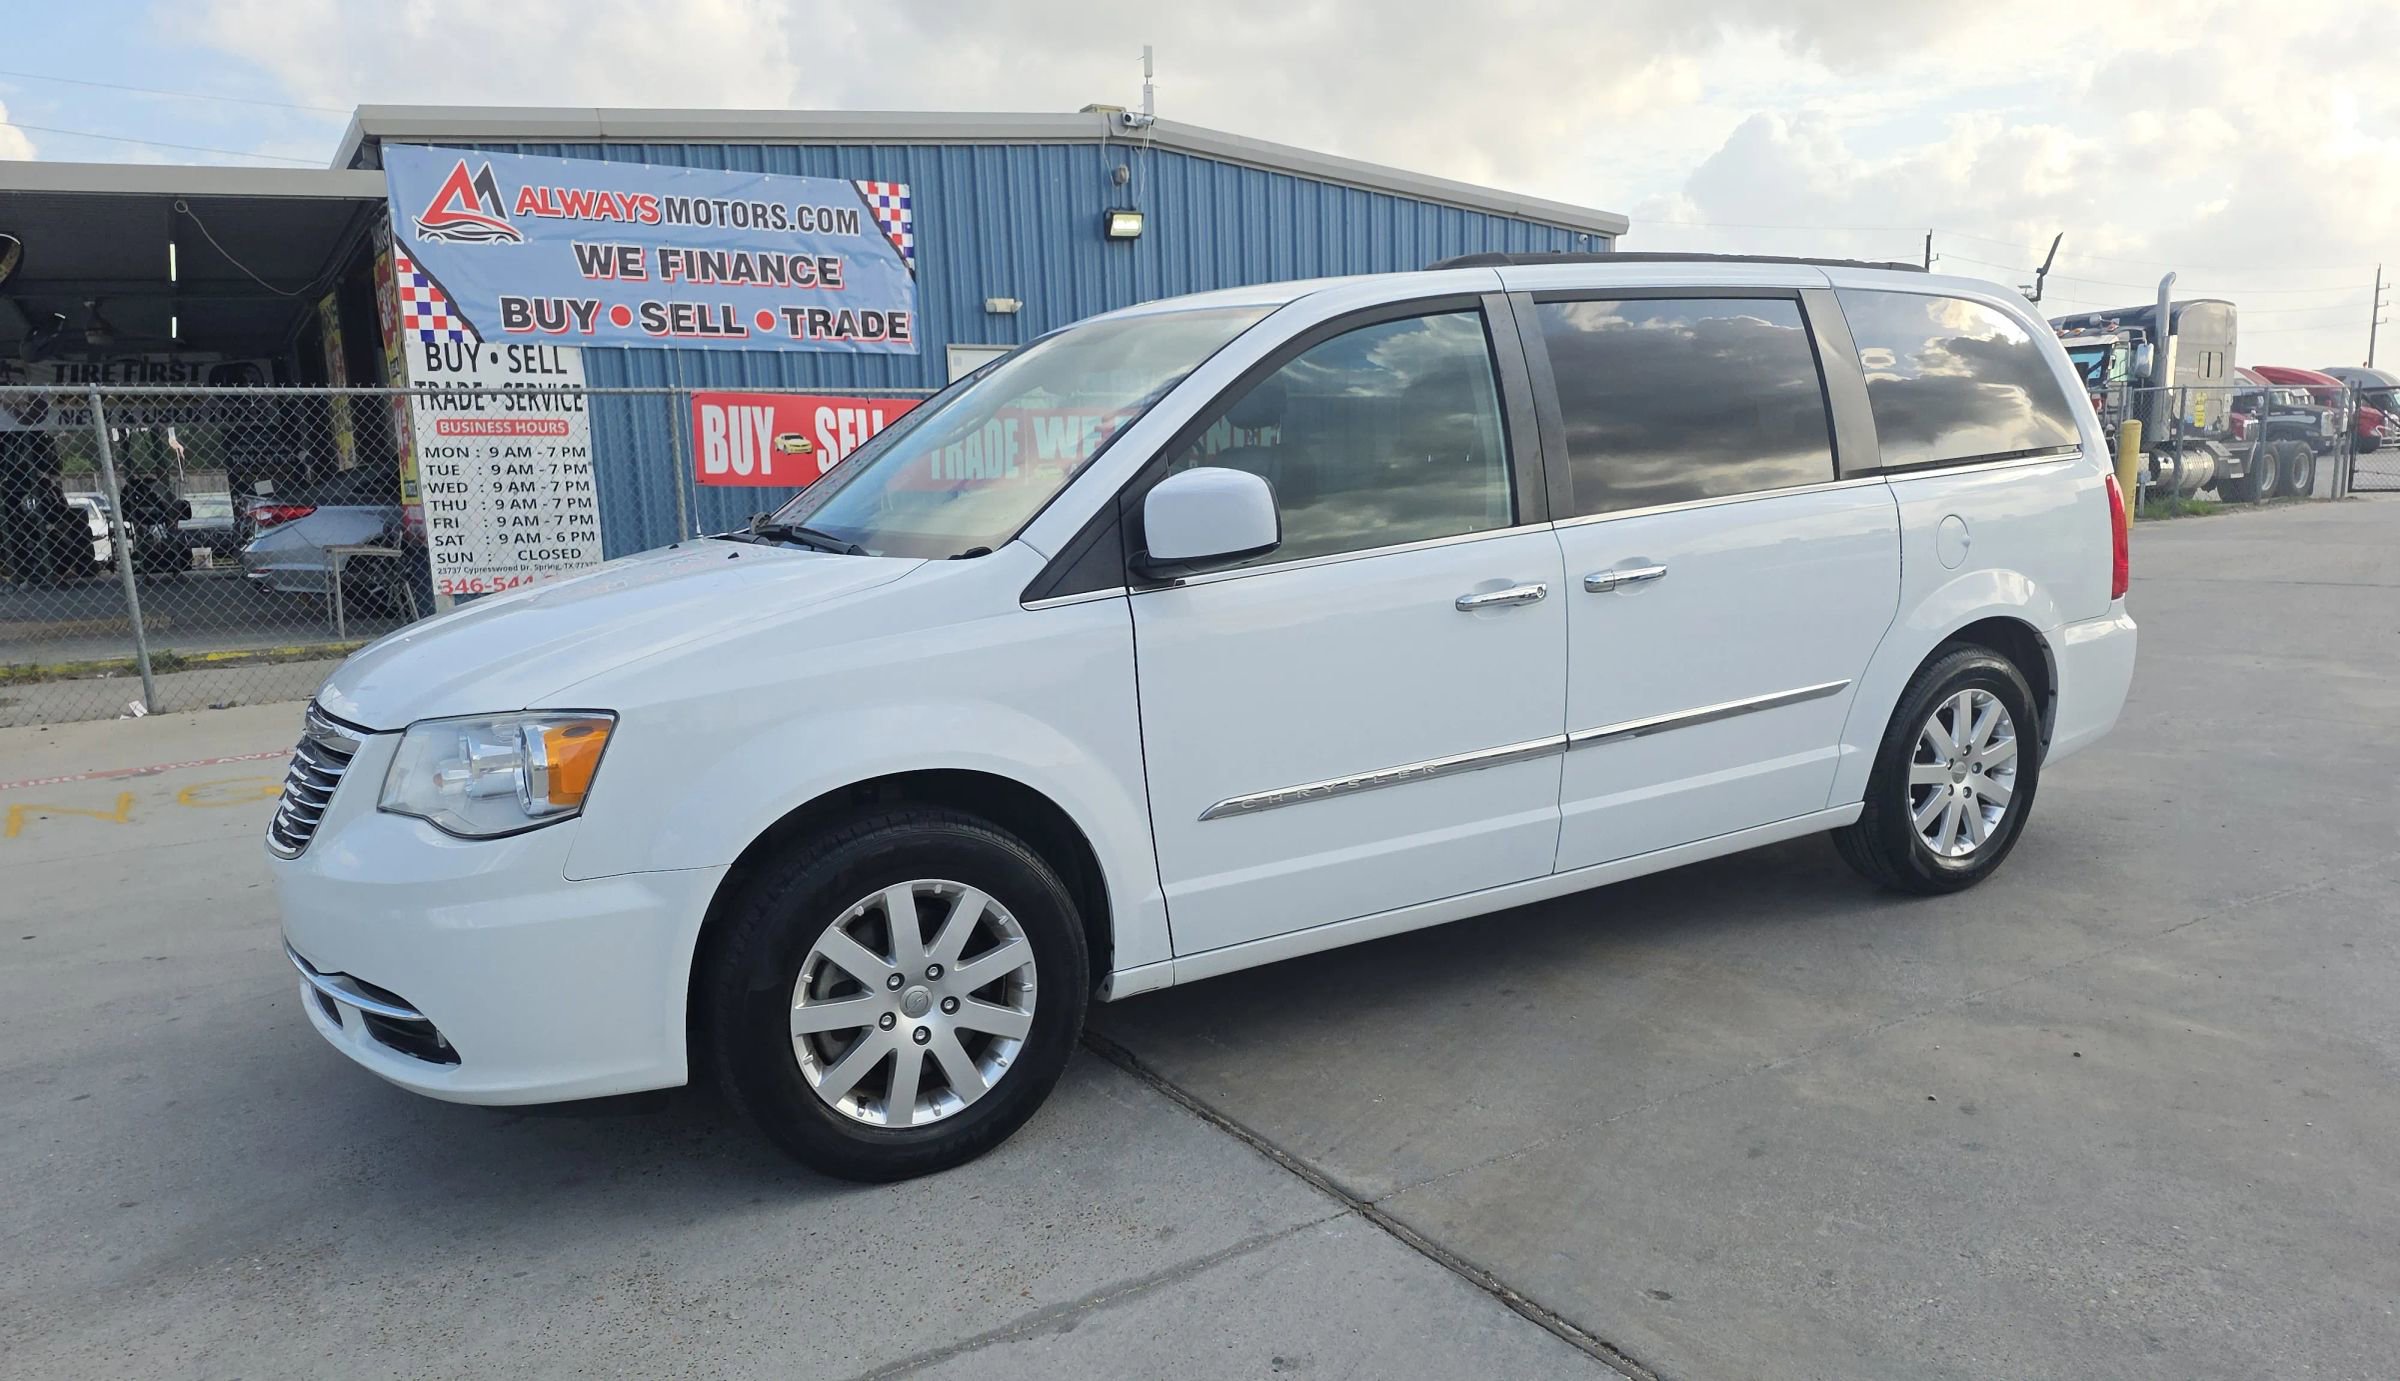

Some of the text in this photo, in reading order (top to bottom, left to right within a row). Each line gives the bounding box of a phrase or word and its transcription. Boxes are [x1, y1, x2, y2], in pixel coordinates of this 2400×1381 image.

[571, 241, 846, 291] WE FINANCE
[500, 296, 912, 343] BUY SELL TRADE
[425, 341, 481, 373] BUY
[507, 344, 568, 374] SELL
[51, 361, 204, 384] TIRE FIRST
[414, 380, 584, 412] TRADE SERVICE
[440, 421, 565, 434] BUSINESS HOURS
[701, 404, 775, 476] BUY
[425, 447, 470, 459] MON
[489, 446, 499, 458] 9
[504, 446, 532, 458] AM
[546, 446, 555, 458] 7
[562, 446, 586, 458] PM
[426, 464, 460, 476] TUE
[491, 464, 501, 476] 9
[506, 464, 534, 475] AM
[548, 464, 558, 475] 7
[563, 464, 588, 475] PM
[427, 482, 468, 494] WED
[492, 481, 503, 493] 9
[508, 481, 536, 493] AM
[550, 481, 559, 492] 7
[565, 480, 590, 492] PM
[430, 499, 467, 512] THU
[494, 499, 505, 510] 9
[509, 499, 538, 510] AM
[552, 498, 561, 509] 7
[567, 497, 592, 509] PM
[433, 517, 460, 529] FRI
[496, 516, 507, 527] 9
[511, 515, 539, 527] AM
[553, 515, 563, 526] 7
[569, 514, 594, 526] PM
[434, 534, 466, 547] SAT
[499, 533, 509, 545] 9
[514, 532, 541, 544] AM
[556, 532, 566, 543] 6
[570, 531, 596, 543] PM
[436, 552, 474, 564] SUN
[517, 548, 582, 562] CLOSED
[1240, 763, 1437, 810] CHRYSLER
